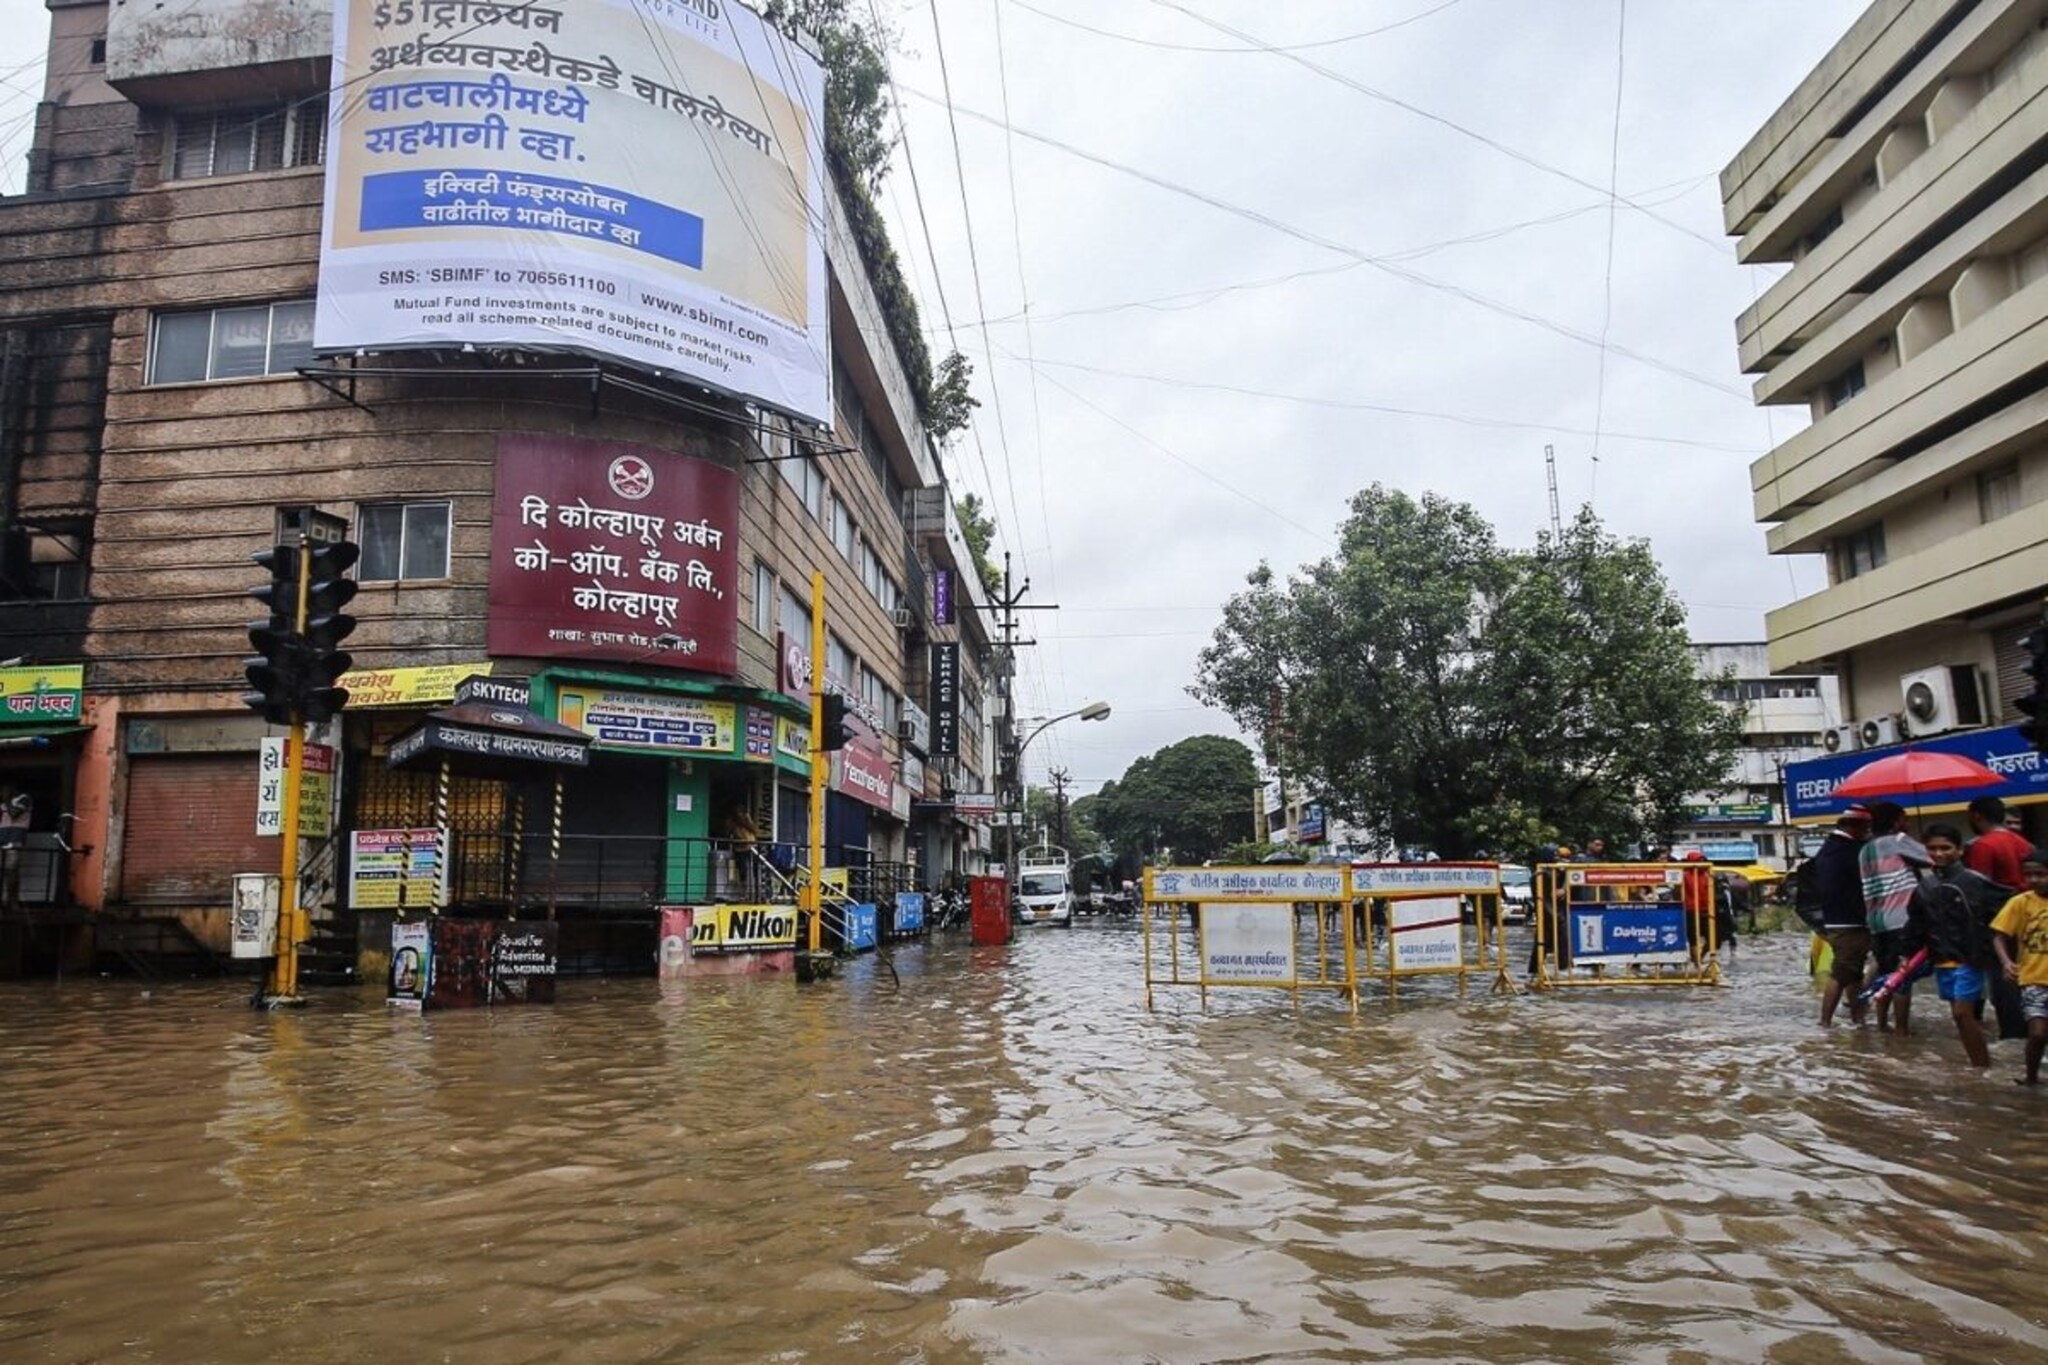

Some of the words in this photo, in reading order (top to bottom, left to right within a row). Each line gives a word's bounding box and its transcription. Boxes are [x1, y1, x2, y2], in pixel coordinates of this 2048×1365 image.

[685, 14, 720, 41] LIFE
[367, 72, 590, 123] वाटचालीमध्ये
[369, 33, 622, 93] अर्थव्यवस्थेकडे
[631, 75, 773, 156] चाललेल्या
[365, 113, 509, 154] सहभागी
[519, 128, 586, 162] व्हा.
[423, 172, 500, 198] इक्विटी
[506, 176, 628, 216] फंड्ससोबत
[423, 199, 510, 222] वाढीतील
[517, 206, 604, 236] भागीदार
[610, 223, 641, 246] व्हा
[378, 270, 420, 285] SMS:
[494, 269, 511, 283] to
[517, 270, 616, 296] 7065611100
[641, 291, 769, 347] www.sbimf.com
[394, 298, 440, 310] Mutual
[445, 297, 481, 309] Fund
[485, 297, 577, 313] investments
[581, 305, 604, 318] are
[609, 309, 659, 333] subject
[663, 322, 676, 337] to
[680, 331, 721, 354] market
[725, 346, 755, 366] risks.
[422, 312, 451, 324] read
[456, 312, 474, 323] all
[479, 312, 537, 325] scheme
[540, 313, 592, 330] related
[597, 320, 673, 351] documents
[677, 346, 732, 373] carefully.
[520, 495, 549, 529] दि
[558, 498, 665, 547] कोल्हापूर
[673, 519, 722, 551] अर्बन
[573, 579, 679, 627] कोल्हापूर
[7, 694, 37, 713] पान
[39, 694, 76, 713] भवन
[472, 681, 529, 704] SKYTECH
[1797, 776, 1844, 799] FEDERA
[728, 910, 794, 940] Nikon
[1612, 925, 1657, 938] Dalmia
